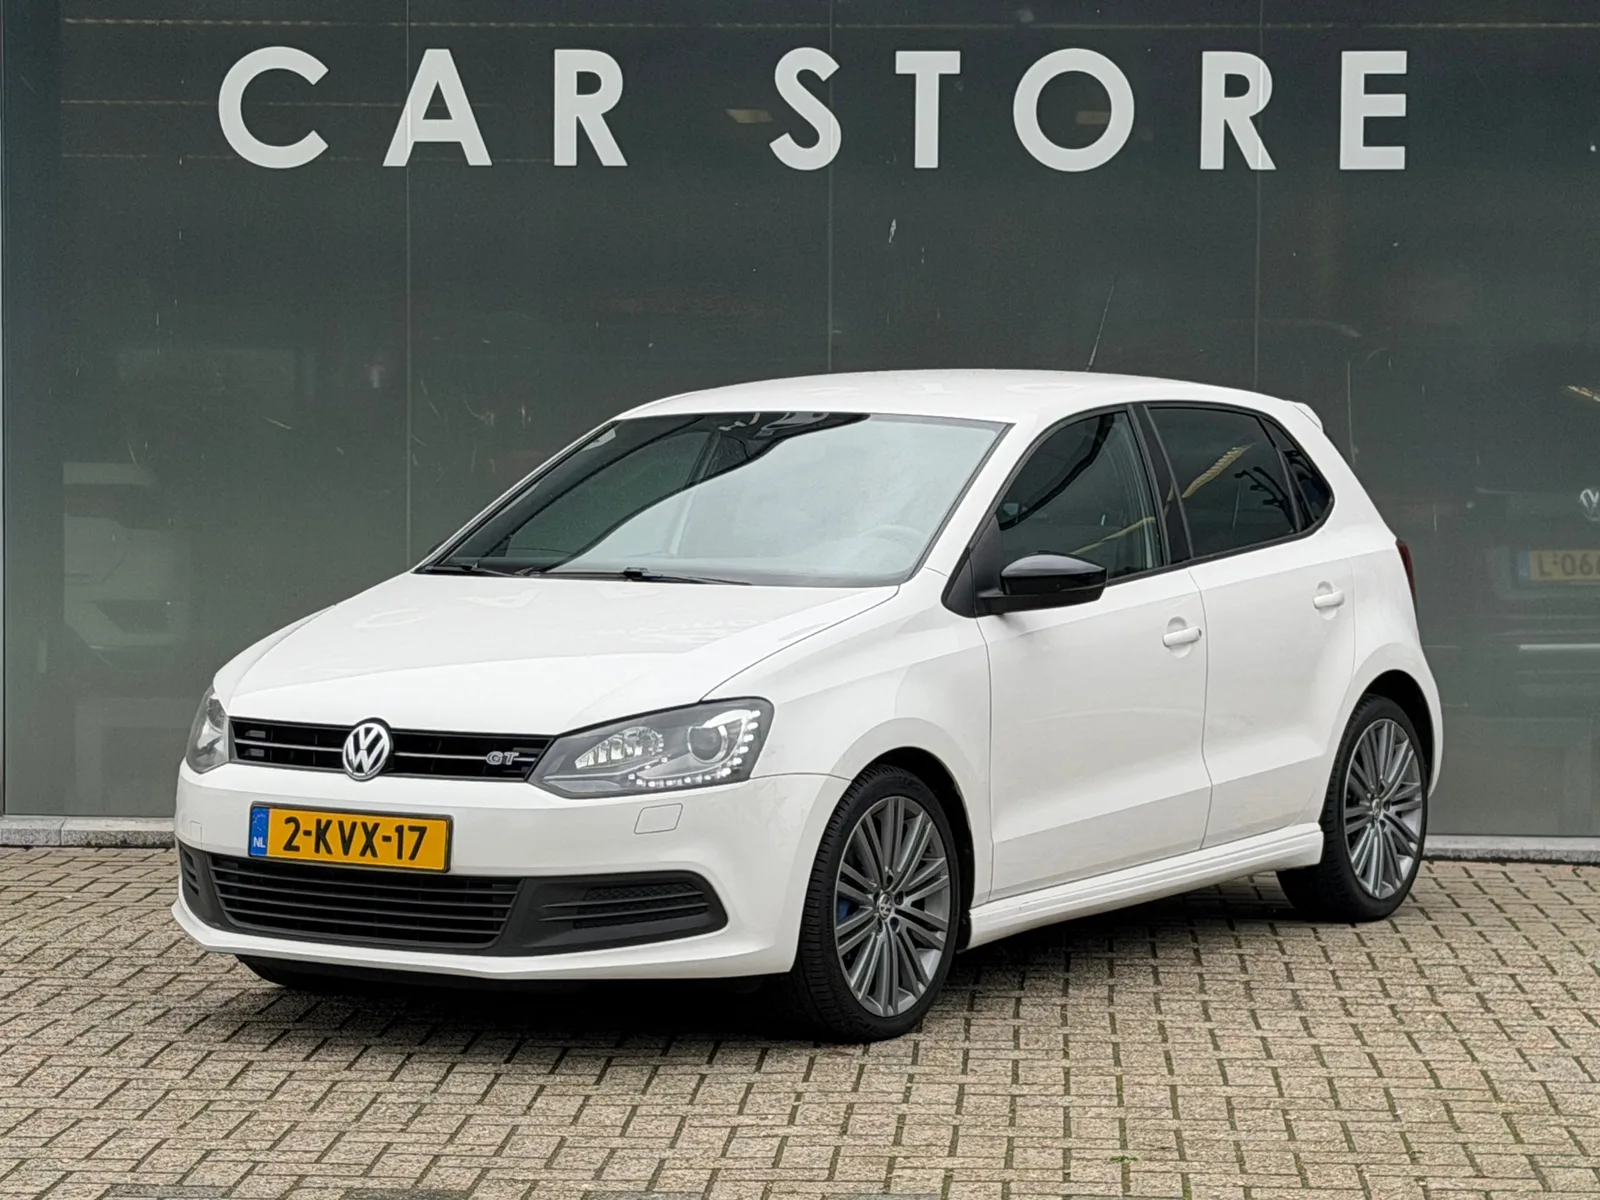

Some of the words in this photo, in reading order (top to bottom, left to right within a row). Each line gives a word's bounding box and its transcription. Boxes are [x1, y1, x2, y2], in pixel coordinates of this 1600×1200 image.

[218, 46, 628, 169] CAR
[769, 47, 1407, 172] STORE
[1537, 551, 1600, 577] L-06
[343, 722, 391, 779] VW
[485, 750, 520, 766] GT
[252, 836, 266, 849] NL
[282, 816, 428, 862] 2-KVX-17
